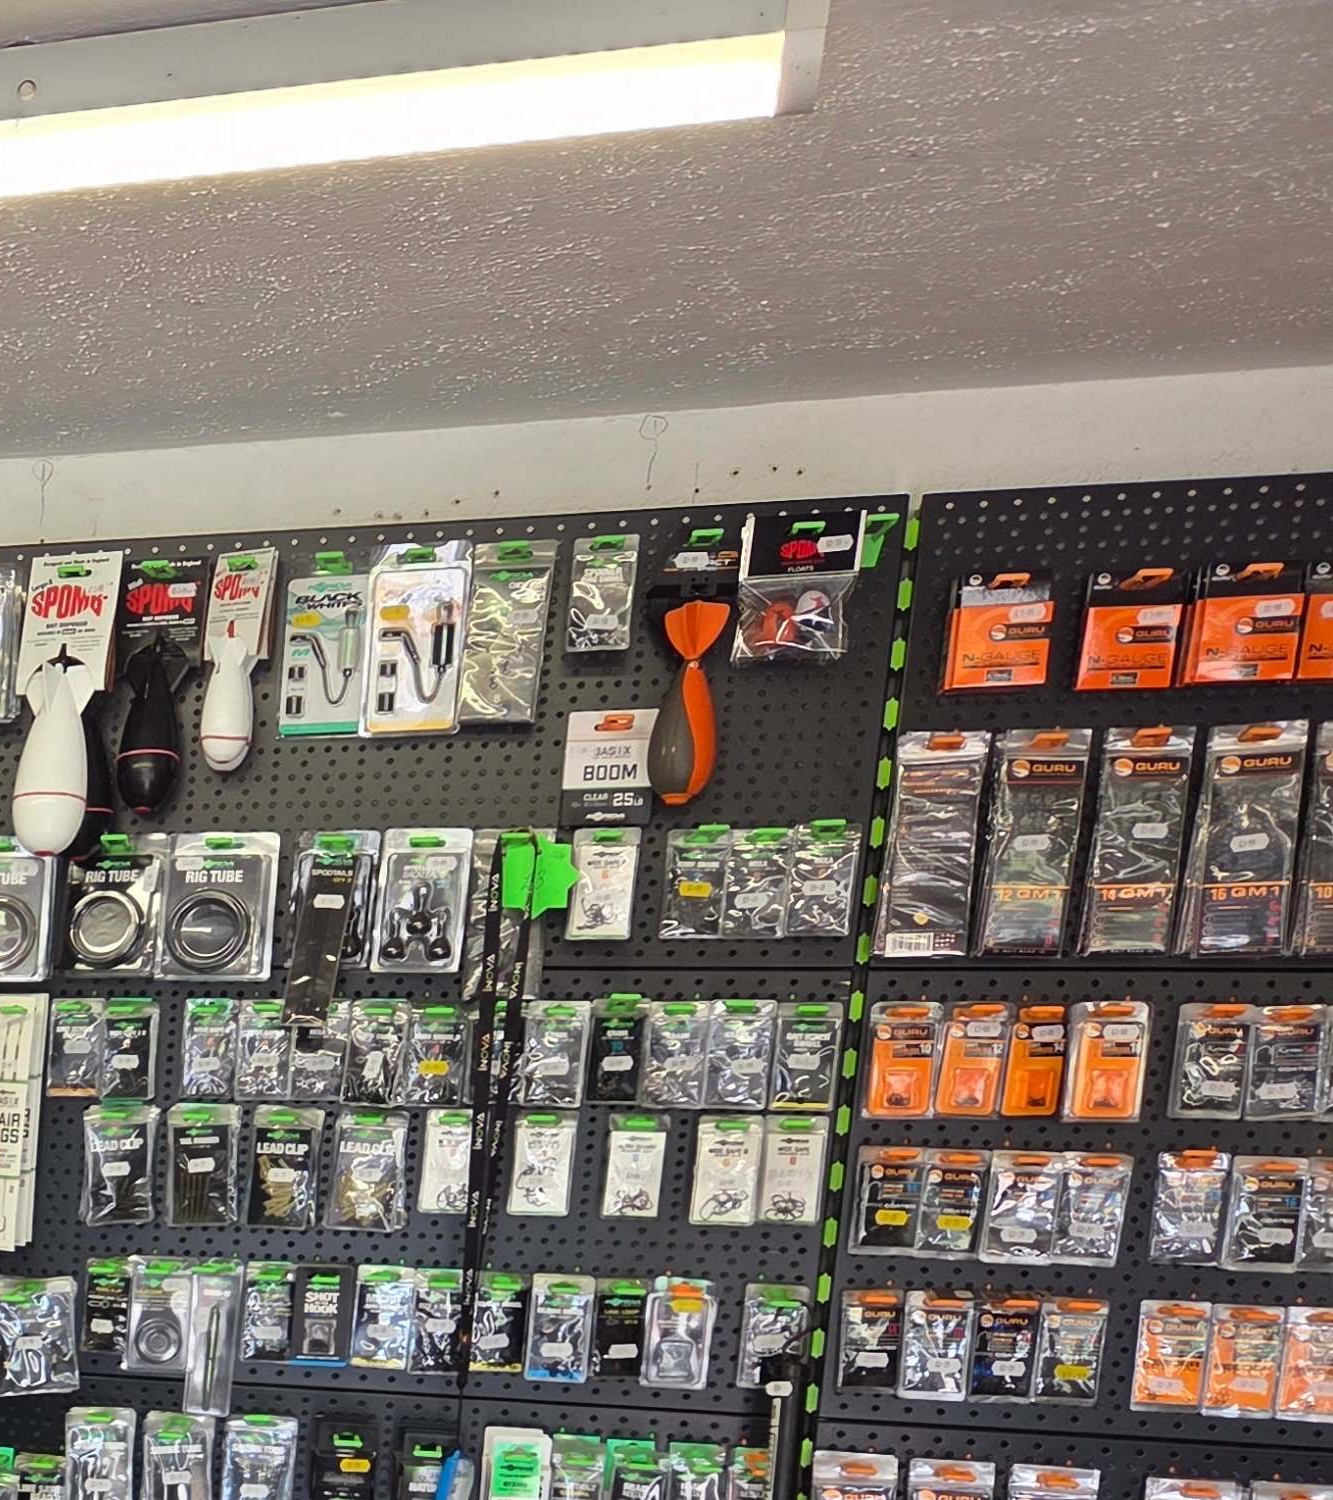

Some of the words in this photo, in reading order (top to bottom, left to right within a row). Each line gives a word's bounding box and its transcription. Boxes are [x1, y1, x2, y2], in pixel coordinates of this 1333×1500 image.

[788, 565, 814, 573] FLOATS
[295, 591, 362, 604] BLACK
[1008, 625, 1045, 636] GURU
[1136, 627, 1172, 638] GURU
[1032, 763, 1076, 774] GURU
[1136, 761, 1181, 773] GURU
[1244, 756, 1293, 769] GURU
[583, 764, 637, 781] BOOM
[583, 793, 608, 801] CLEAR
[85, 870, 105, 883] RIG
[108, 870, 139, 883] TUBE
[185, 870, 208, 883] RIG
[211, 870, 243, 883] TUBE
[257, 1142, 283, 1154] LEAD
[340, 1141, 367, 1154] LEAD
[885, 1167, 917, 1177] GURU
[1261, 1180, 1295, 1190] GURU
